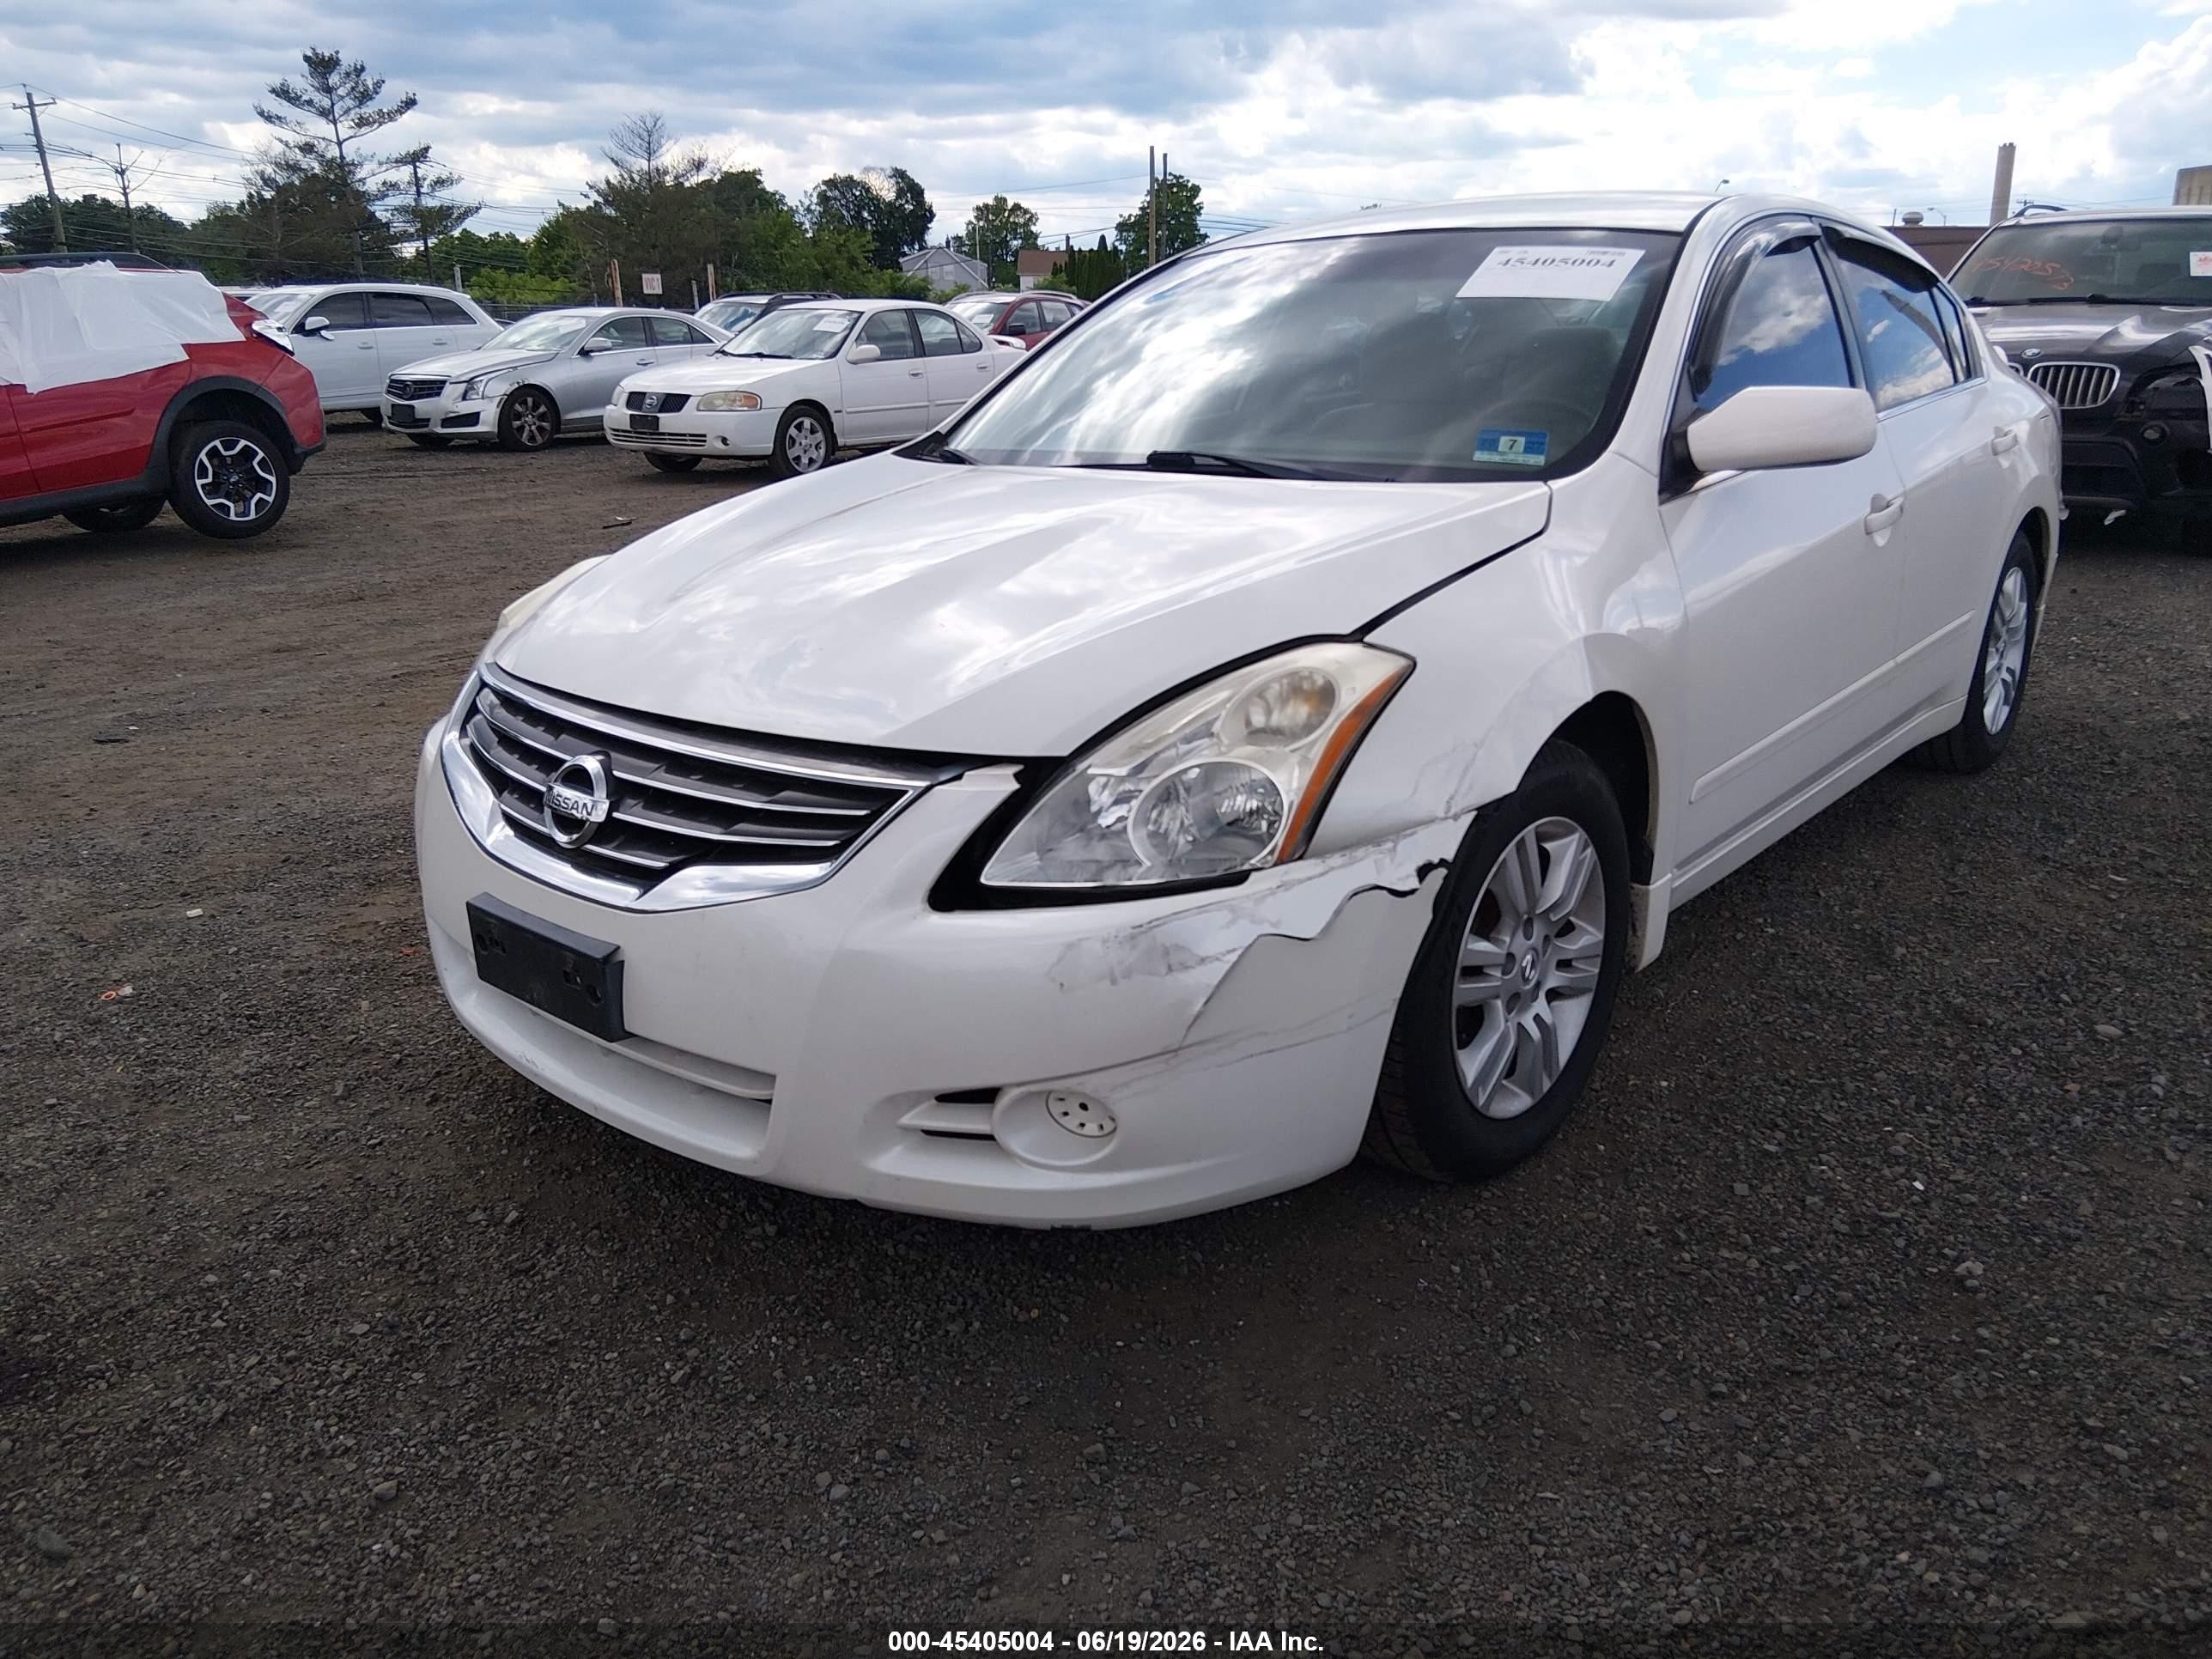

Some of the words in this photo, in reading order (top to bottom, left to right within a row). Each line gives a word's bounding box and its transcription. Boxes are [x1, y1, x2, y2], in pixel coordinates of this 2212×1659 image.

[1497, 257, 1616, 269] 45405004
[1508, 439, 1518, 451] 7
[544, 788, 595, 817] NISSAN
